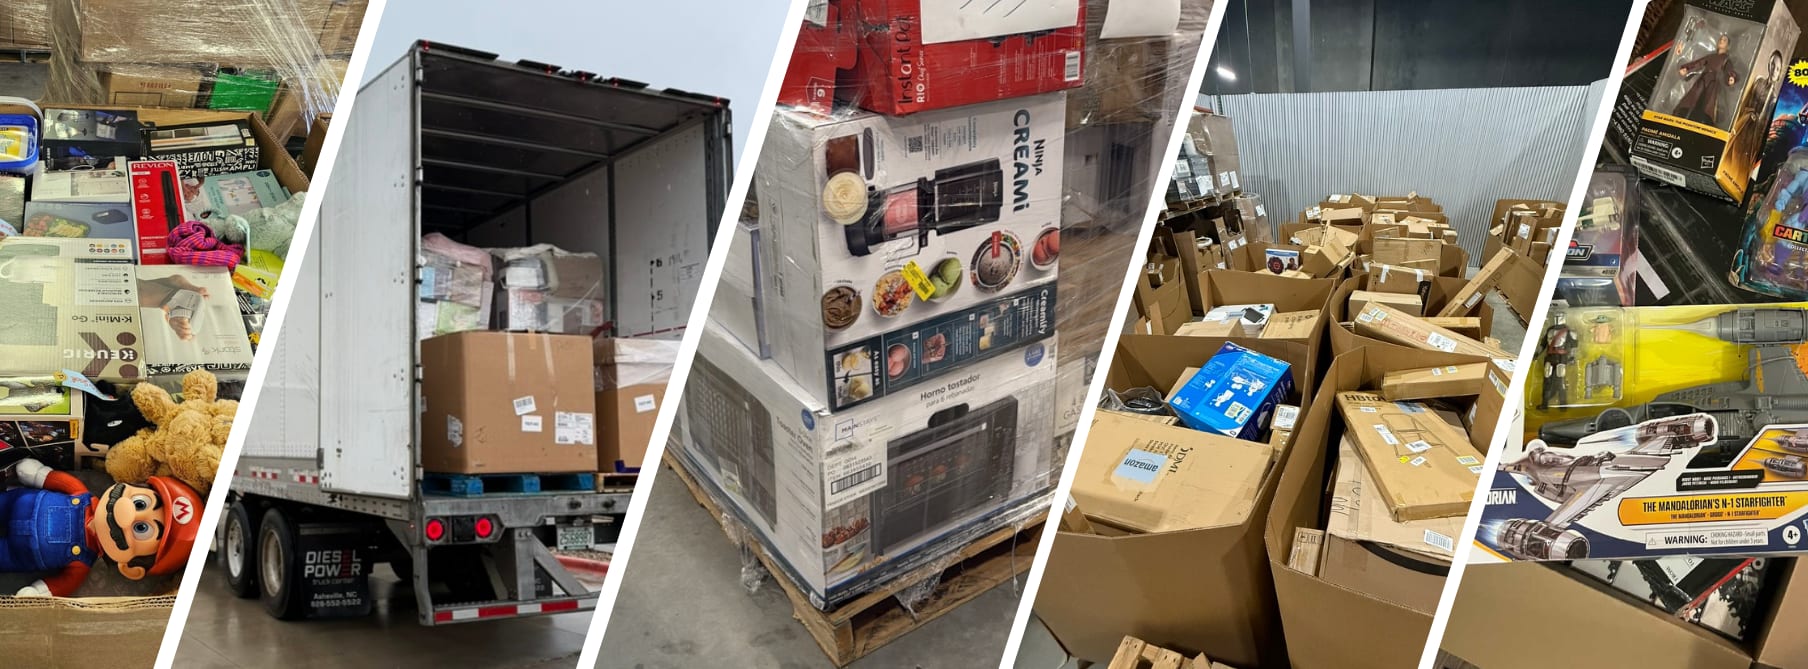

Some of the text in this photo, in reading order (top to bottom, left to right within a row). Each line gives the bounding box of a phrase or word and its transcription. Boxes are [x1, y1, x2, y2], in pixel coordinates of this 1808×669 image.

[894, 15, 913, 104] Instant Pot
[916, 83, 925, 103] RIO
[133, 161, 174, 169] REVLON
[1031, 139, 1045, 176] NINJA
[72, 315, 88, 323] Go
[1038, 288, 1049, 335] Creamify
[63, 348, 134, 360] KEURIG
[920, 373, 981, 401] Horno tostador
[1124, 457, 1159, 472] amazon
[175, 500, 192, 519] M
[1643, 501, 1657, 512] THE
[1658, 498, 1720, 511] MANDALORIAN'S
[1722, 498, 1734, 508] N-1
[1664, 535, 1708, 545] WARNING:
[1787, 530, 1798, 539] 4+
[305, 549, 362, 564] DIESEL
[304, 563, 361, 578] POWER
